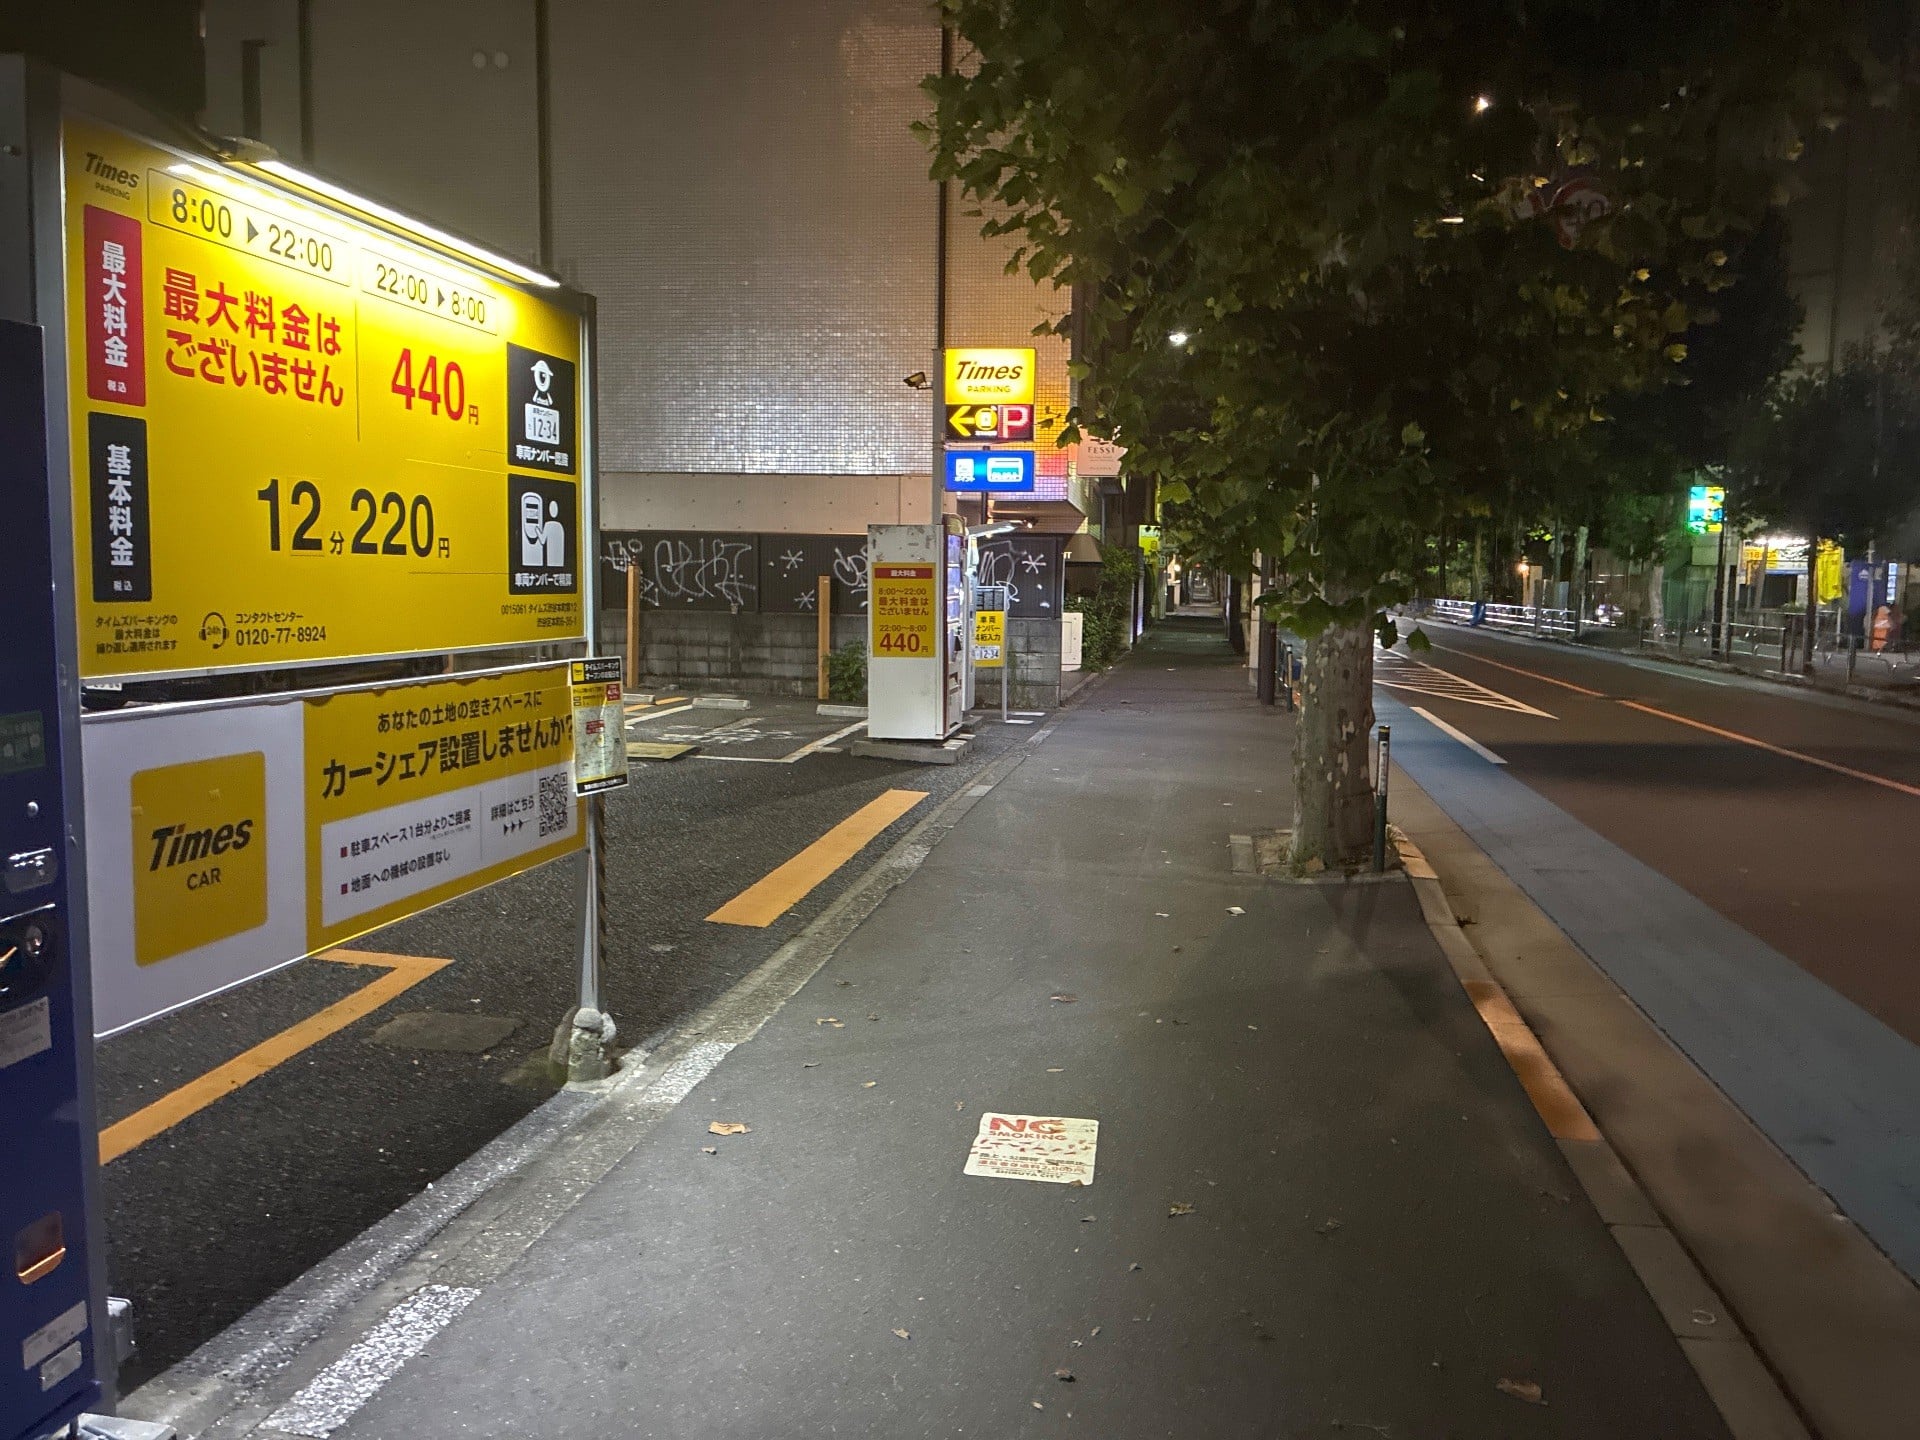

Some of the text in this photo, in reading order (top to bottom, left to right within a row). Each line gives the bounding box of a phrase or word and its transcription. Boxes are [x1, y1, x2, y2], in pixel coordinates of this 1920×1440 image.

[84, 152, 140, 188] Times
[95, 181, 131, 201] PARKING
[172, 188, 332, 272] 8:00 22:00
[102, 240, 129, 368] 最大料金
[376, 263, 485, 324] 22:00 8:00
[163, 266, 342, 356] 最大料金は
[165, 328, 344, 407] ございません
[956, 361, 1023, 380] Times
[967, 385, 1011, 393] PARKING
[1002, 406, 1029, 438] P
[107, 443, 134, 566] 基本料金
[890, 569, 917, 577] 最大料金
[878, 597, 929, 606] 最大料金は
[878, 607, 929, 616] ございません
[95, 614, 178, 628] タイムズパーキングの
[235, 611, 304, 624] コンタクトセンター
[975, 624, 1001, 632] ナンバー
[980, 615, 996, 624] 車両
[235, 626, 327, 646] 0120-77-8924
[377, 691, 543, 733] あなたの土地の空きスペースに
[490, 796, 535, 821] 詳細はこちら
[350, 809, 472, 858] 駐車スペース1台分よりご提案
[149, 819, 254, 873] Times
[186, 867, 221, 891] CAR
[350, 848, 451, 893] 地面への機械の設置なし
[989, 1130, 1068, 1142] SMOKING
